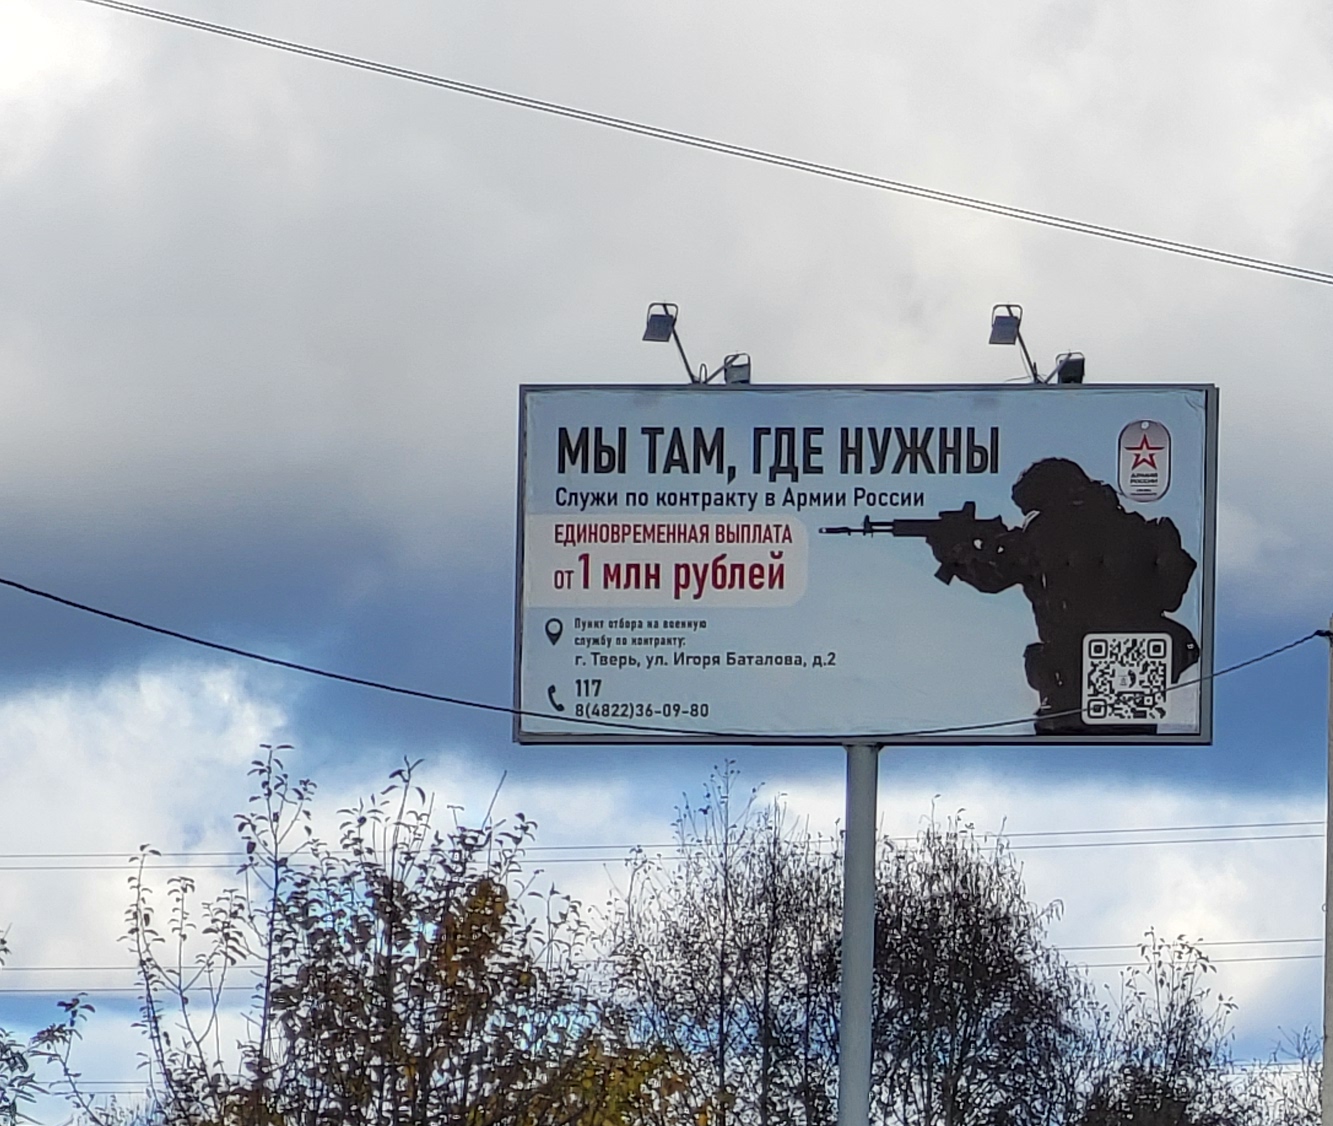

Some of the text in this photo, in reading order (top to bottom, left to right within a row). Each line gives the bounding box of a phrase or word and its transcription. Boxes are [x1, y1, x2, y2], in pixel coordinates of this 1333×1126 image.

[557, 427, 999, 485] МЫ ТАМ, ГДЕ НУЖНЫ
[555, 487, 925, 512] Служи по контракту в Армии России
[554, 524, 793, 547] ЕДИНОВРЕМЕННАЯ ВЫПЛАТА
[554, 551, 785, 600] от 1 млн рублей
[574, 617, 707, 631] Пункт отбора на военную
[574, 635, 612, 648] службу
[616, 636, 627, 645] по
[575, 652, 837, 669] г. Тверь, ул. Игоря Баталова, д.2
[575, 679, 602, 697] 117
[575, 702, 709, 719] 8(4822)36-09-80
